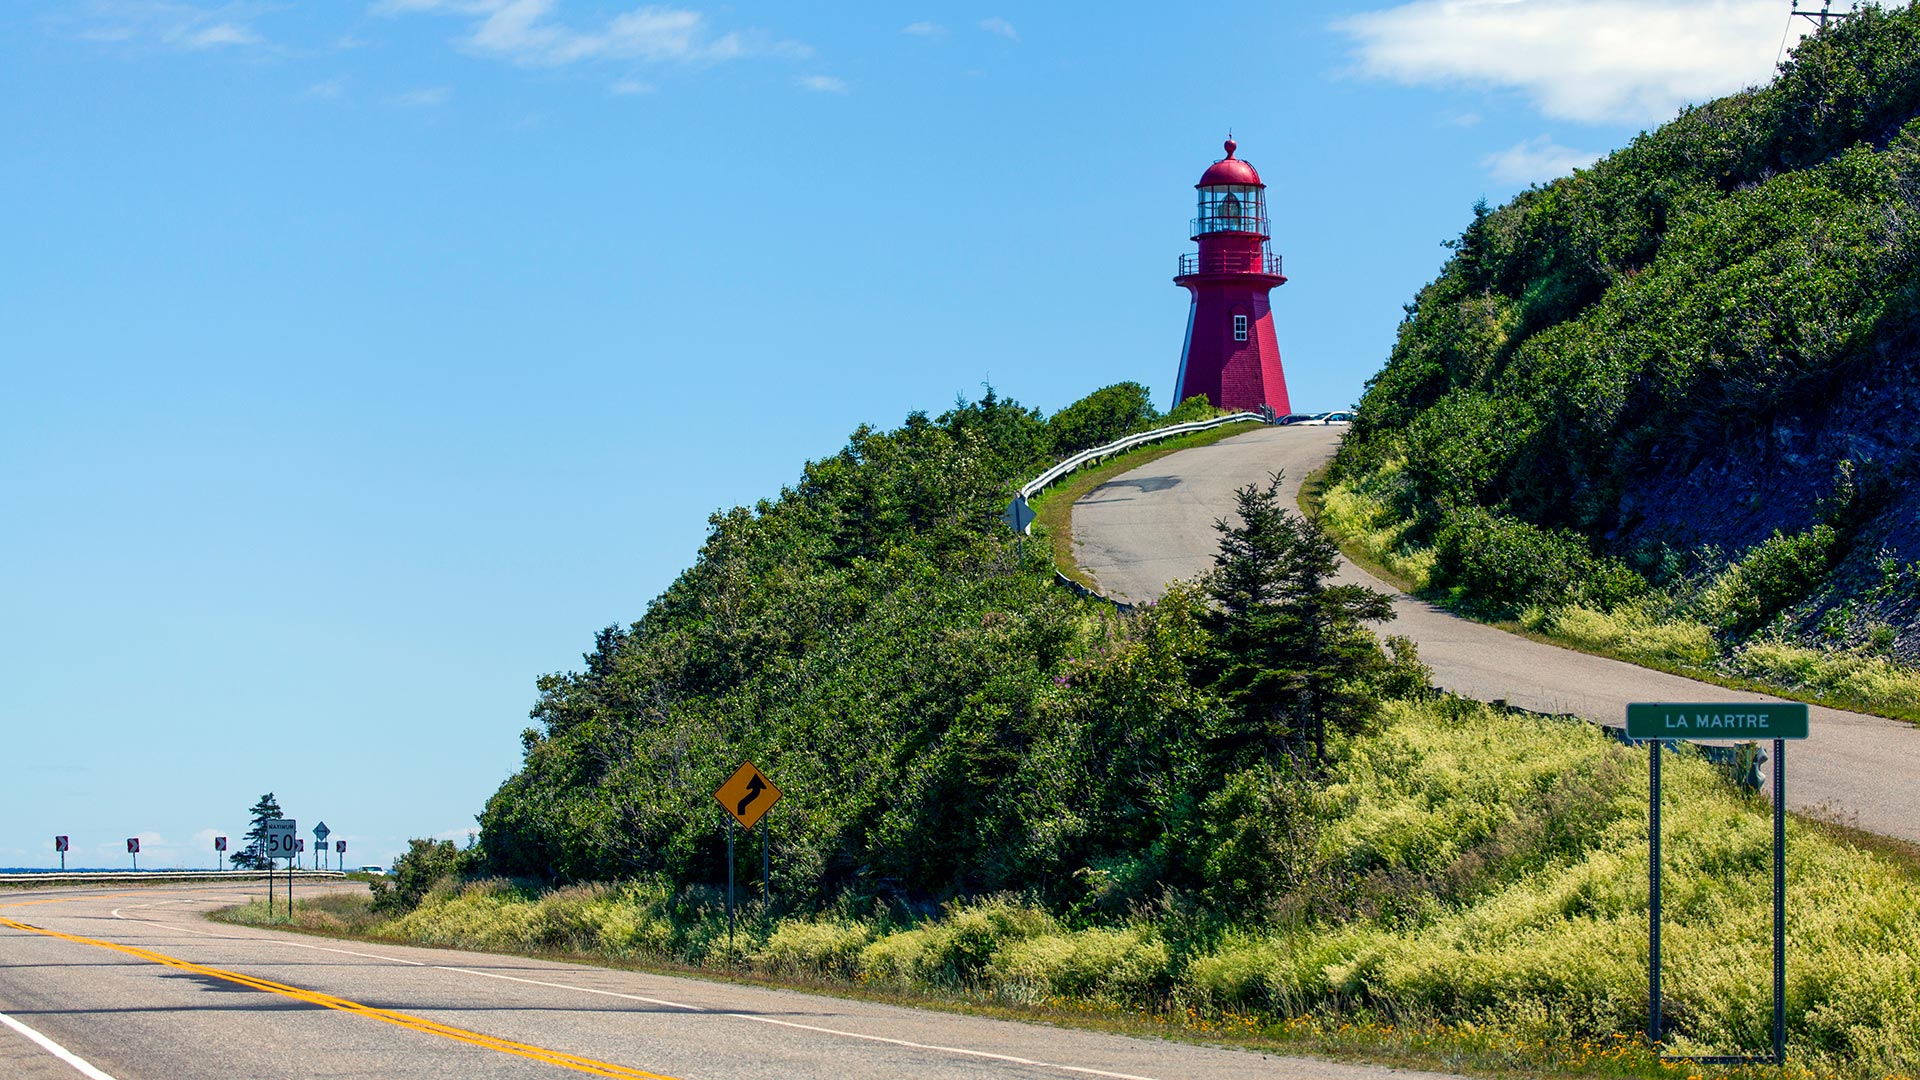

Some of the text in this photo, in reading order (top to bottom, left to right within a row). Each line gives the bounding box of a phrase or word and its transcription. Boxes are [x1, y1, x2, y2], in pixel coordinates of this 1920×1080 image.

[1665, 714, 1769, 728] LA MARTRE
[269, 834, 293, 852] 50
